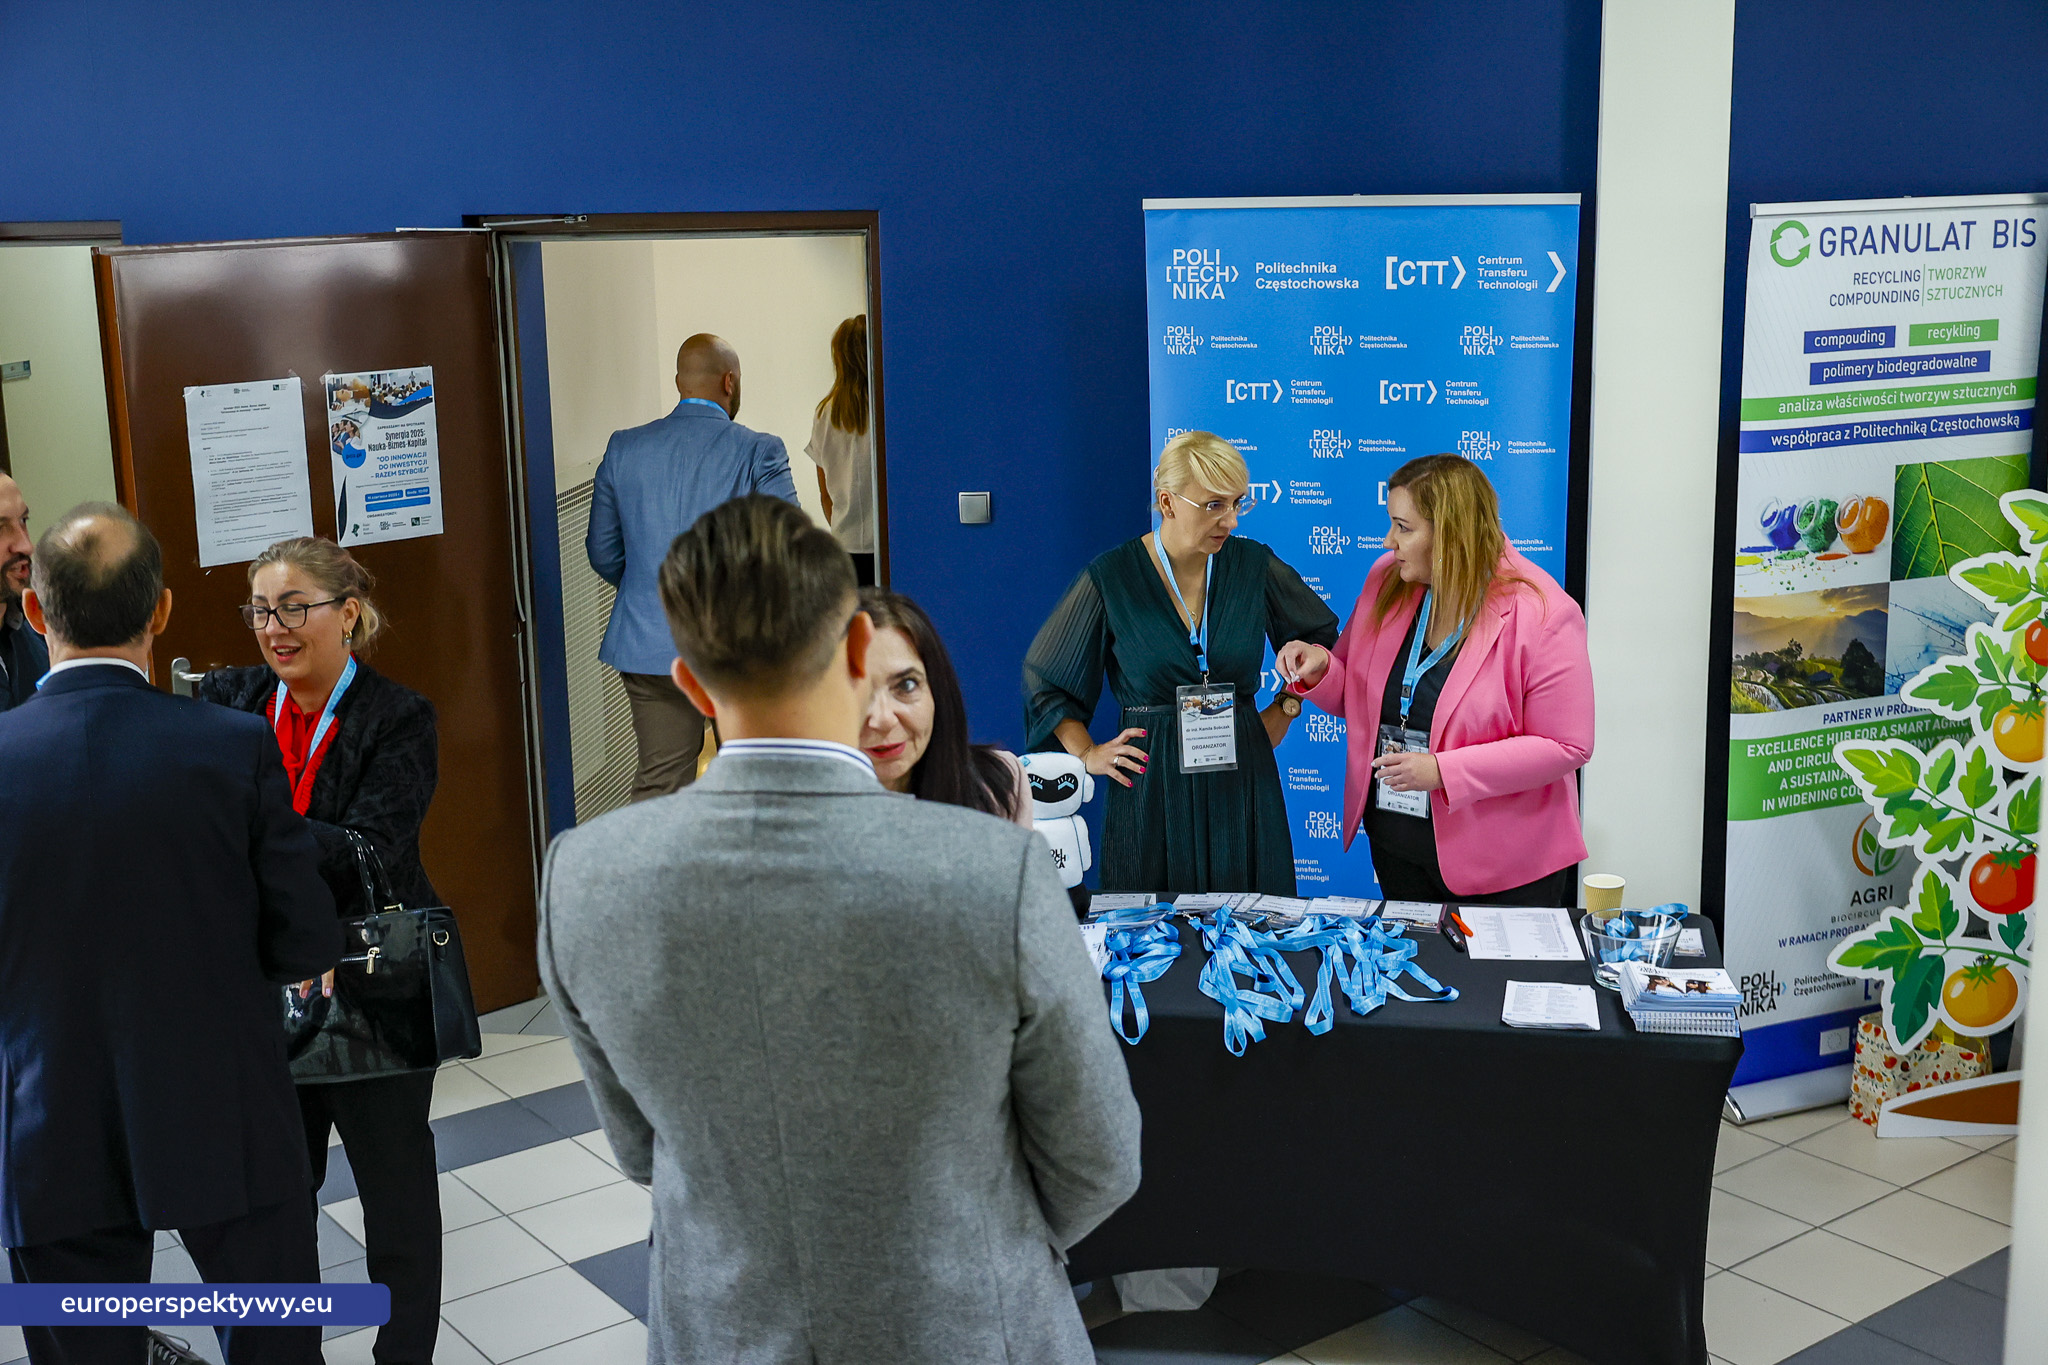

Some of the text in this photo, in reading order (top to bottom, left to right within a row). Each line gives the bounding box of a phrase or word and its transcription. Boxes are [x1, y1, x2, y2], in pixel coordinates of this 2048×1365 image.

[1819, 218, 2038, 258] GRANULAT BIS
[1173, 248, 1220, 265] POLI
[1478, 256, 1523, 265] Centrum
[1255, 262, 1337, 274] Politechnika
[1478, 268, 1528, 277] Transferu
[1852, 266, 1987, 286] RECYCLING TWORZYW
[1255, 278, 1360, 292] Częstochowska
[1477, 280, 1538, 291] Technologii
[1173, 283, 1226, 300] NIKA
[1829, 284, 2003, 307] COMPOUNDING SZTUCZNYCH
[1166, 326, 1194, 336] POLI
[1314, 326, 1342, 336] POLI
[1464, 326, 1493, 336] POLI
[1927, 324, 1981, 343] recykling
[1813, 329, 1886, 350] compouding
[1167, 346, 1197, 355] NIKA
[1314, 346, 1345, 356] NIKA
[1464, 346, 1496, 356] NIKA
[1822, 354, 1978, 382] polimery biodegradowalne
[1291, 397, 1334, 405] Technologii
[1445, 398, 1489, 406] Technologii
[1778, 381, 2018, 414] analiza właściwości tworzyw sztucznych
[386, 430, 410, 441] Synergia
[1313, 430, 1342, 439] POLI
[1462, 431, 1490, 440] POLI
[1770, 412, 2020, 450] współpraca z Politechniką Częstochowską
[390, 452, 427, 461] INNOWACJI
[1313, 449, 1344, 458] NIKA
[1461, 450, 1493, 460] NIKA
[390, 460, 428, 469] INWESTYCJI
[1290, 498, 1332, 506] Technologii
[1312, 526, 1340, 536] POLI
[1312, 545, 1343, 554] NIKA
[1309, 714, 1337, 724] POLI
[1822, 708, 1872, 724] PARTNER
[1874, 706, 1886, 718] W
[1309, 733, 1340, 742] NIKA
[1746, 734, 1824, 758] EXCELLENCE
[1854, 728, 1878, 740] FOR
[1880, 726, 1888, 737] A
[1890, 719, 1932, 737] SMART
[1767, 758, 1792, 774] AND
[1288, 775, 1322, 783] Transferu
[1780, 769, 1852, 790] A SUSTAINA
[1288, 783, 1329, 792] Technologii
[1762, 798, 1776, 812] IN
[1778, 788, 1838, 809] WIDENING
[1309, 811, 1336, 821] POLI
[1309, 829, 1339, 839] NIKA
[1850, 884, 1894, 907] AGRI
[1830, 908, 1880, 924] BIOCIRCUL
[1778, 938, 1788, 948] W
[1789, 930, 1828, 946] RAMACH
[1740, 970, 1775, 990] POLI
[1793, 979, 1857, 996] Częstochowska
[1740, 998, 1777, 1017] NIKA
